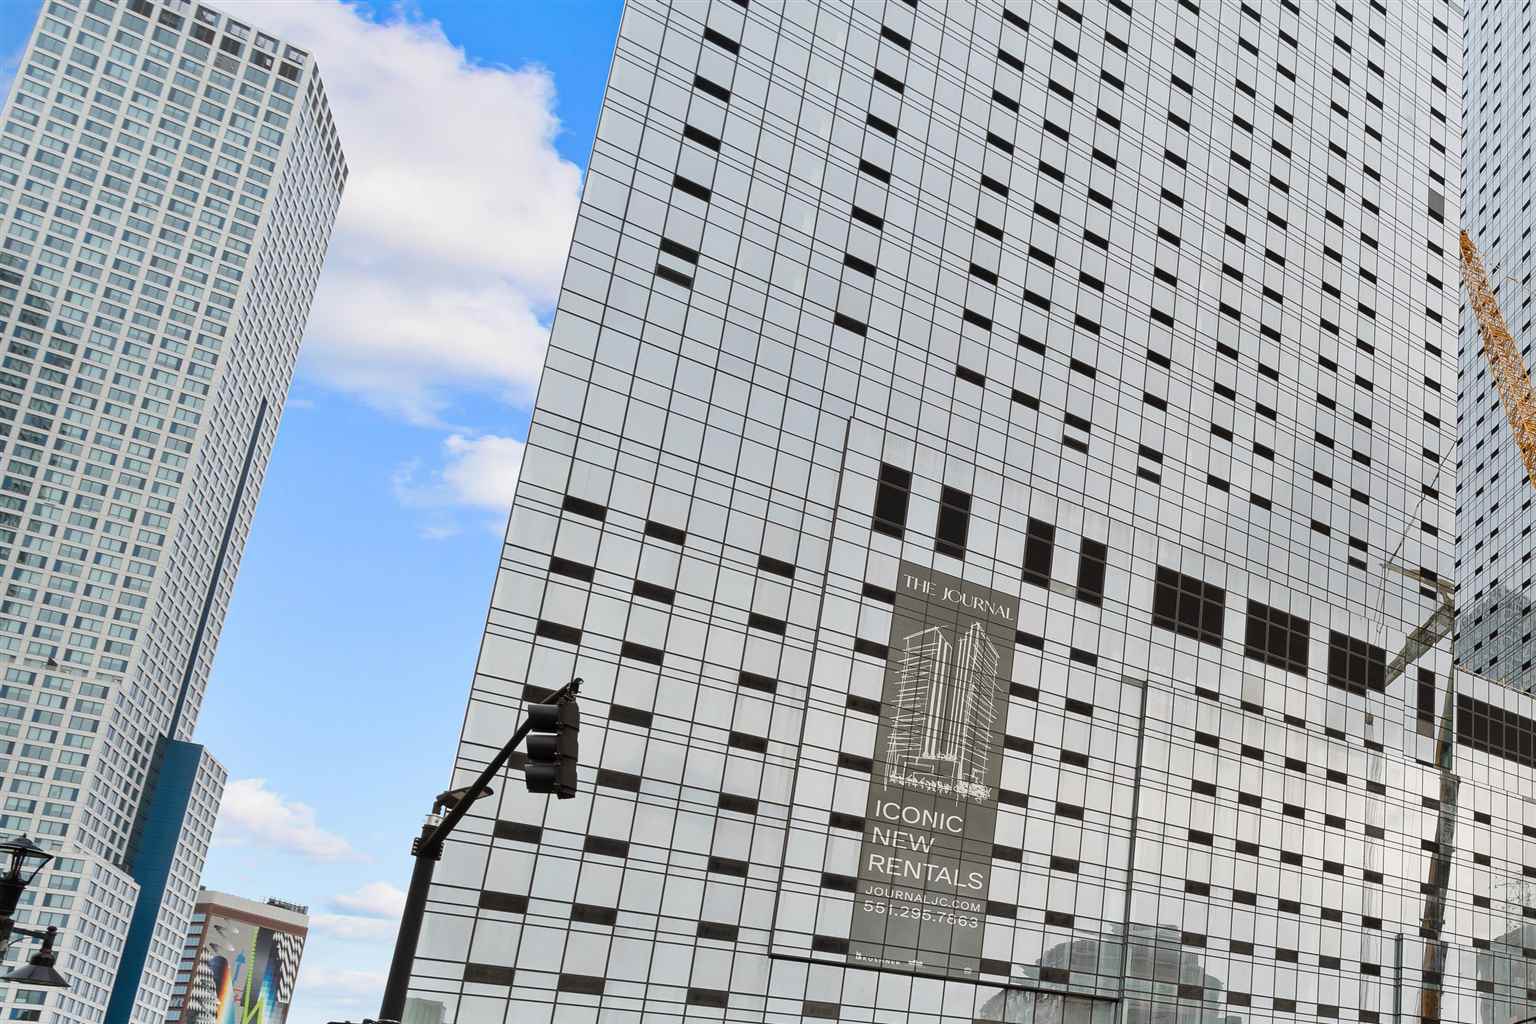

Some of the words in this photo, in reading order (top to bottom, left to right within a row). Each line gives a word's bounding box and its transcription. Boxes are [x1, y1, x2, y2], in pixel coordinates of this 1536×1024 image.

[903, 574, 938, 597] THE
[941, 585, 1015, 621] JOURNAL
[875, 799, 964, 834] ICONIC
[872, 826, 935, 853] NEW
[868, 855, 985, 890] RENTALS
[865, 885, 981, 913] JOURNALJC.COM
